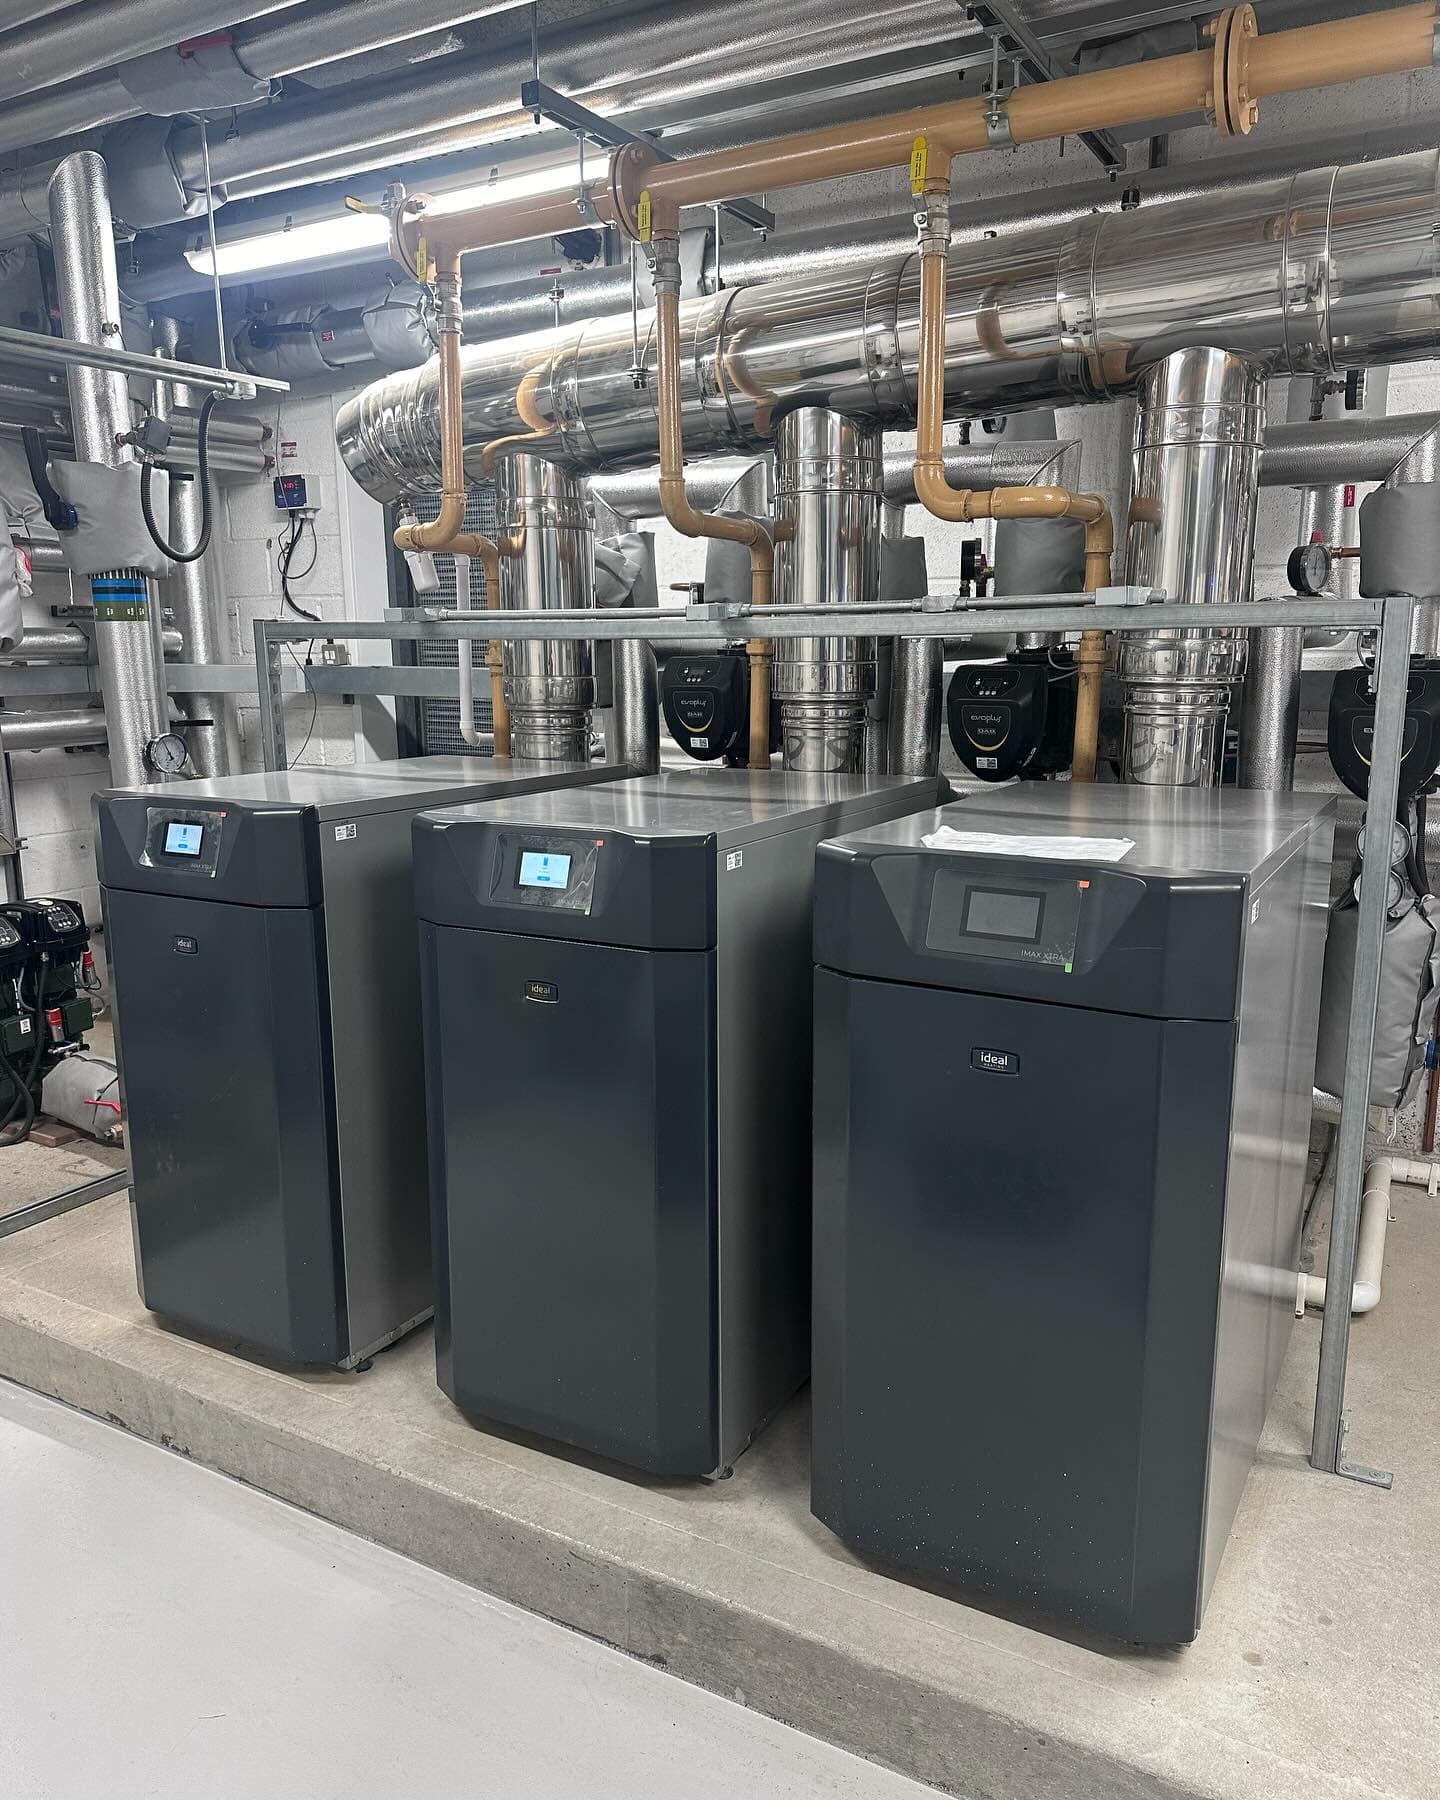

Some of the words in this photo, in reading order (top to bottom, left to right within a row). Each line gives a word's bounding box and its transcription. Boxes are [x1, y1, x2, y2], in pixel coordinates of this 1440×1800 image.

[1021, 949, 1041, 958] IMAX
[1043, 952, 1064, 961] XTRA
[531, 984, 550, 994] ideal
[980, 1051, 1008, 1066] ideal
